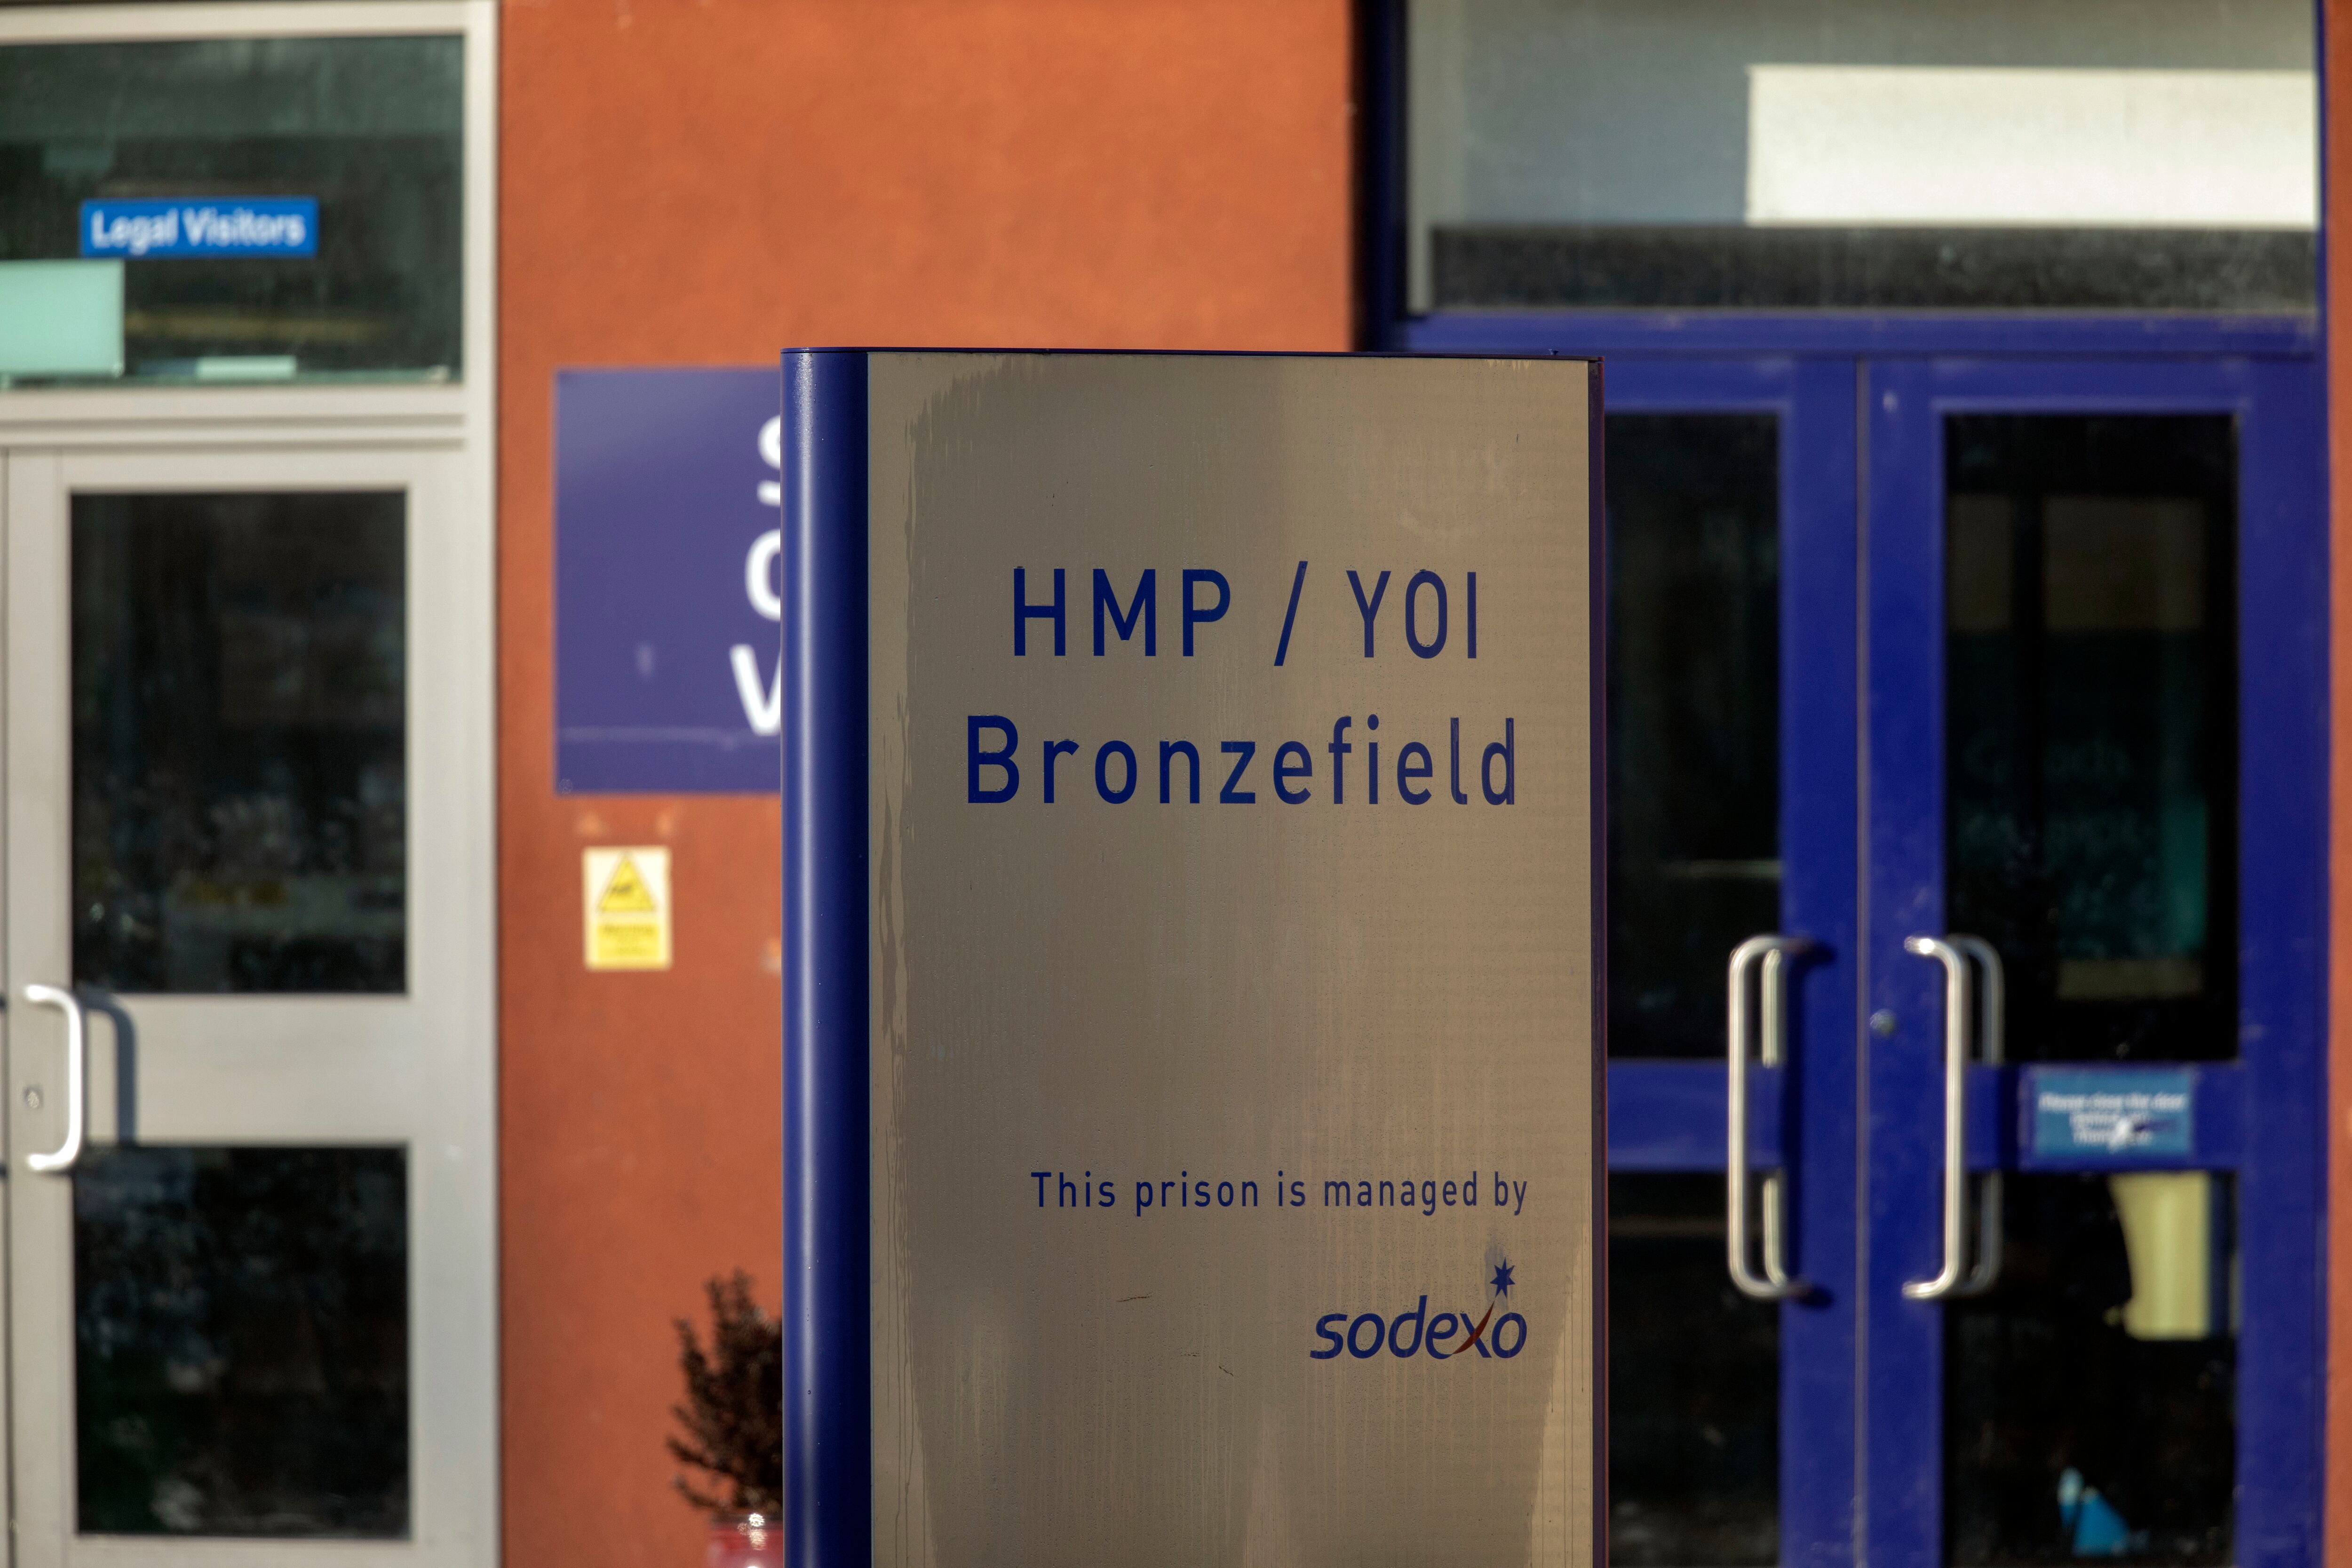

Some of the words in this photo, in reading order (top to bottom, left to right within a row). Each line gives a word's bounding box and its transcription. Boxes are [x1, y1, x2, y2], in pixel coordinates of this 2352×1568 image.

[91, 210, 179, 254] Legal
[183, 208, 306, 246] Visitors
[1013, 567, 1231, 658] HMP
[1274, 561, 1308, 667] /
[1347, 570, 1477, 659] YOI
[967, 714, 1515, 805] Bronzefield
[1031, 1171, 1115, 1208] This
[1136, 1170, 1258, 1217] prison
[1278, 1170, 1305, 1207] is
[1325, 1171, 1477, 1216] managed
[1495, 1171, 1527, 1216] by
[1310, 1295, 1527, 1360] sodexo
